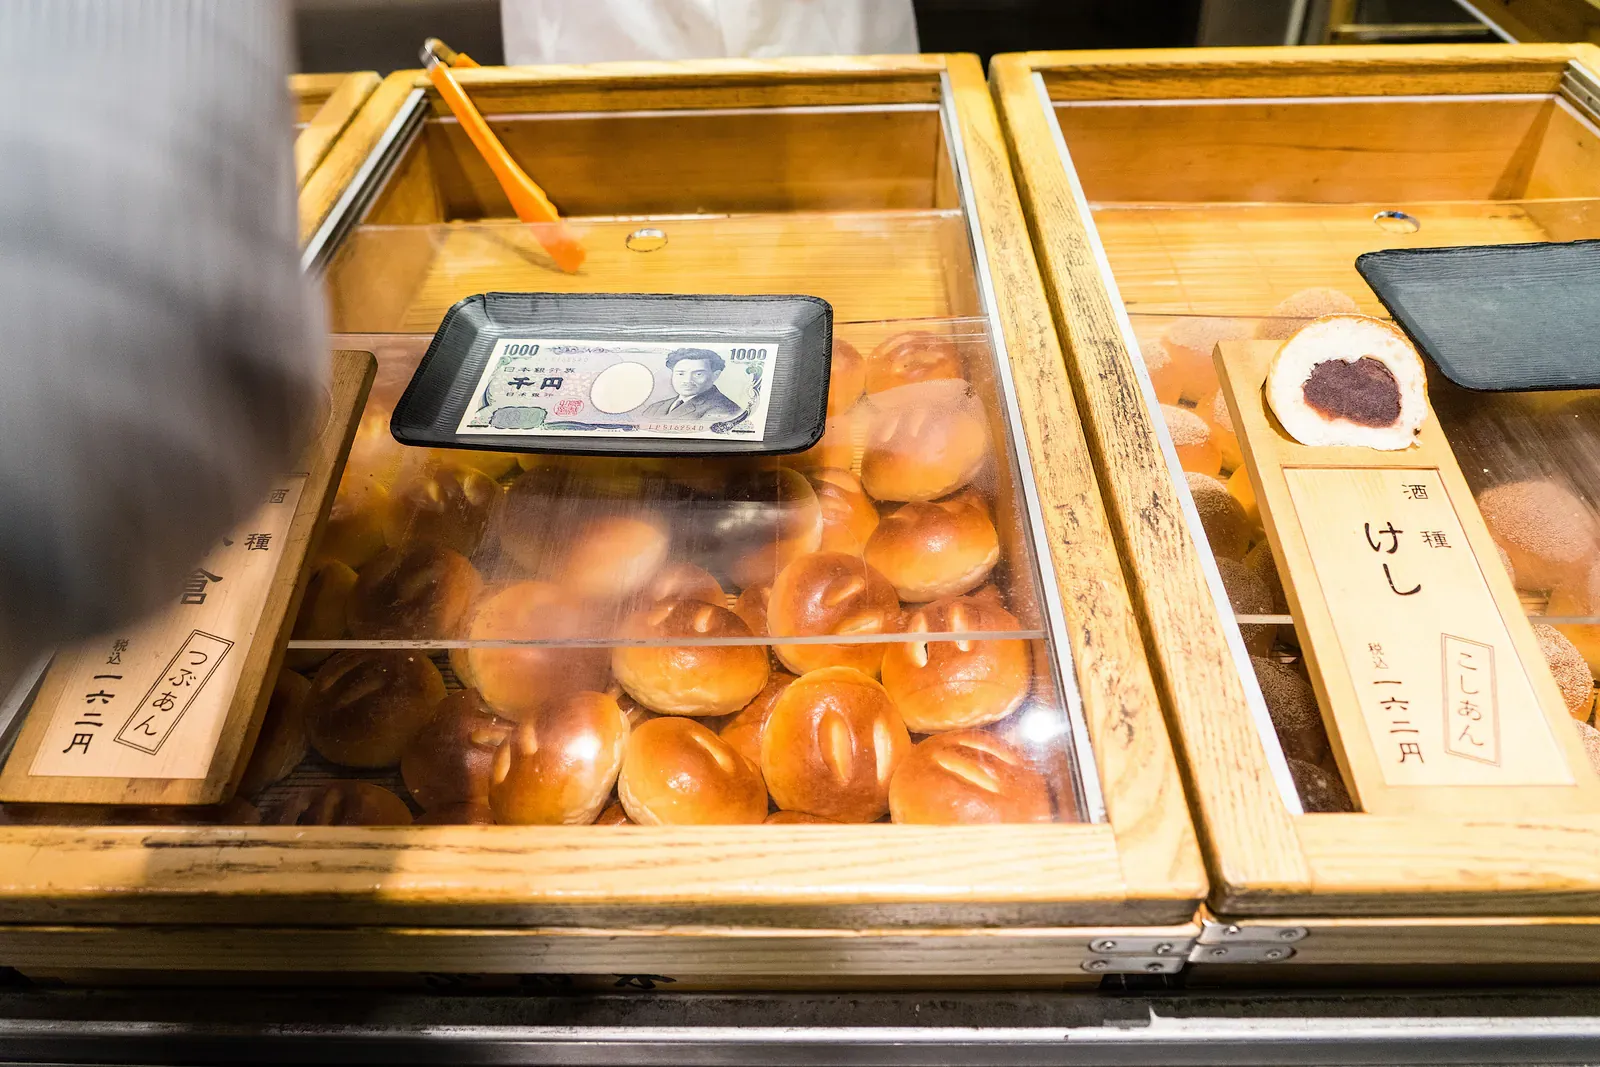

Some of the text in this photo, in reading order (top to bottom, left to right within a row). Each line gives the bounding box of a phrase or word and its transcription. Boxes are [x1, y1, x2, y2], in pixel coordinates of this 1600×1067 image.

[503, 344, 540, 356] 1000
[729, 348, 767, 361] 1000
[507, 376, 564, 390] 千円
[1402, 484, 1452, 549] 酒種
[1364, 521, 1422, 596] けし
[133, 650, 208, 736] つぶあん
[1457, 652, 1484, 747] こしあん
